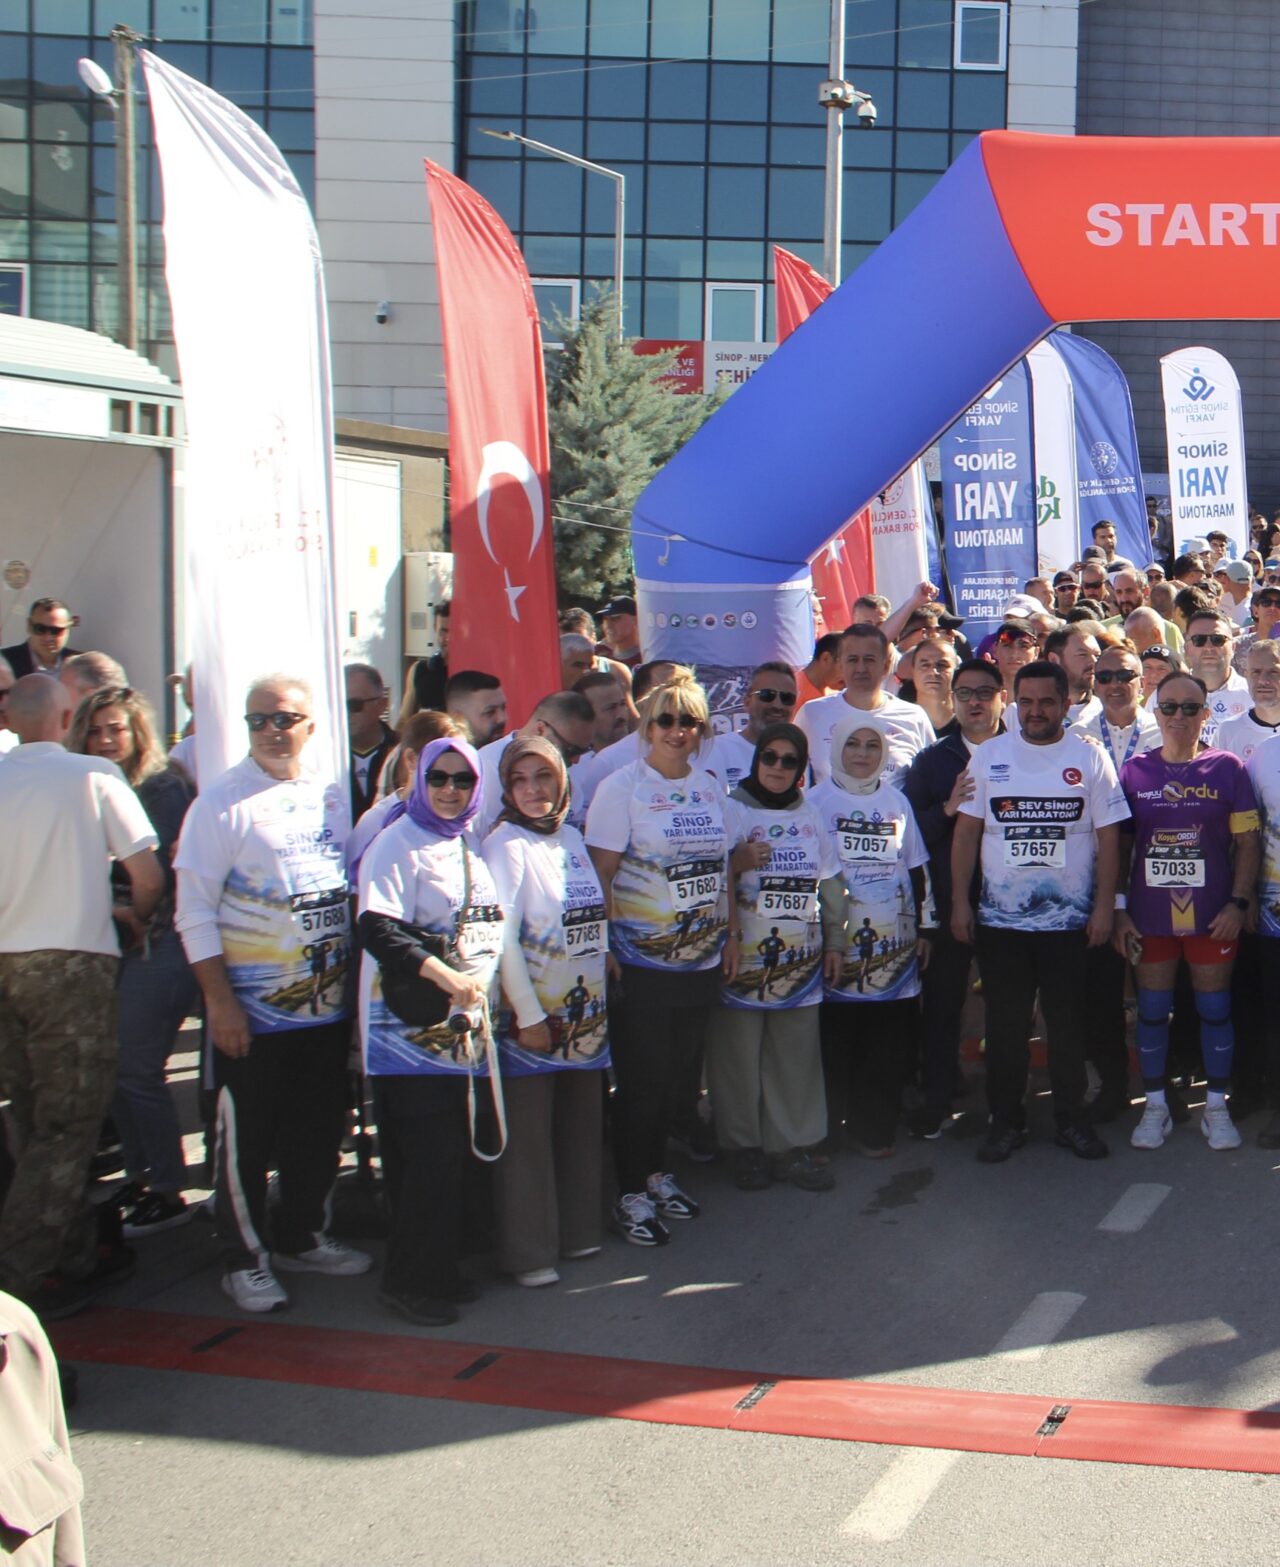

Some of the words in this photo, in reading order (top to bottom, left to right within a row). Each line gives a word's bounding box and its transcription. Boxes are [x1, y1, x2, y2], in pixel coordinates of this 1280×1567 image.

[682, 358, 695, 367] VE
[715, 353, 742, 362] SİNOP
[664, 367, 695, 377] ANLIĞI
[1018, 801, 1042, 810] SEV
[1044, 800, 1080, 810] SİNOP
[998, 811, 1019, 819] YARI
[672, 816, 713, 828] SİNOP
[664, 829, 683, 838] YARI
[844, 836, 889, 853] 57057
[1011, 842, 1057, 856] 57657
[768, 851, 806, 862] İNOP
[775, 862, 818, 872] MARATONU
[1152, 861, 1196, 876] 57033
[566, 886, 598, 899] SİNOP
[677, 876, 718, 899] 57682
[764, 894, 809, 910] 57687
